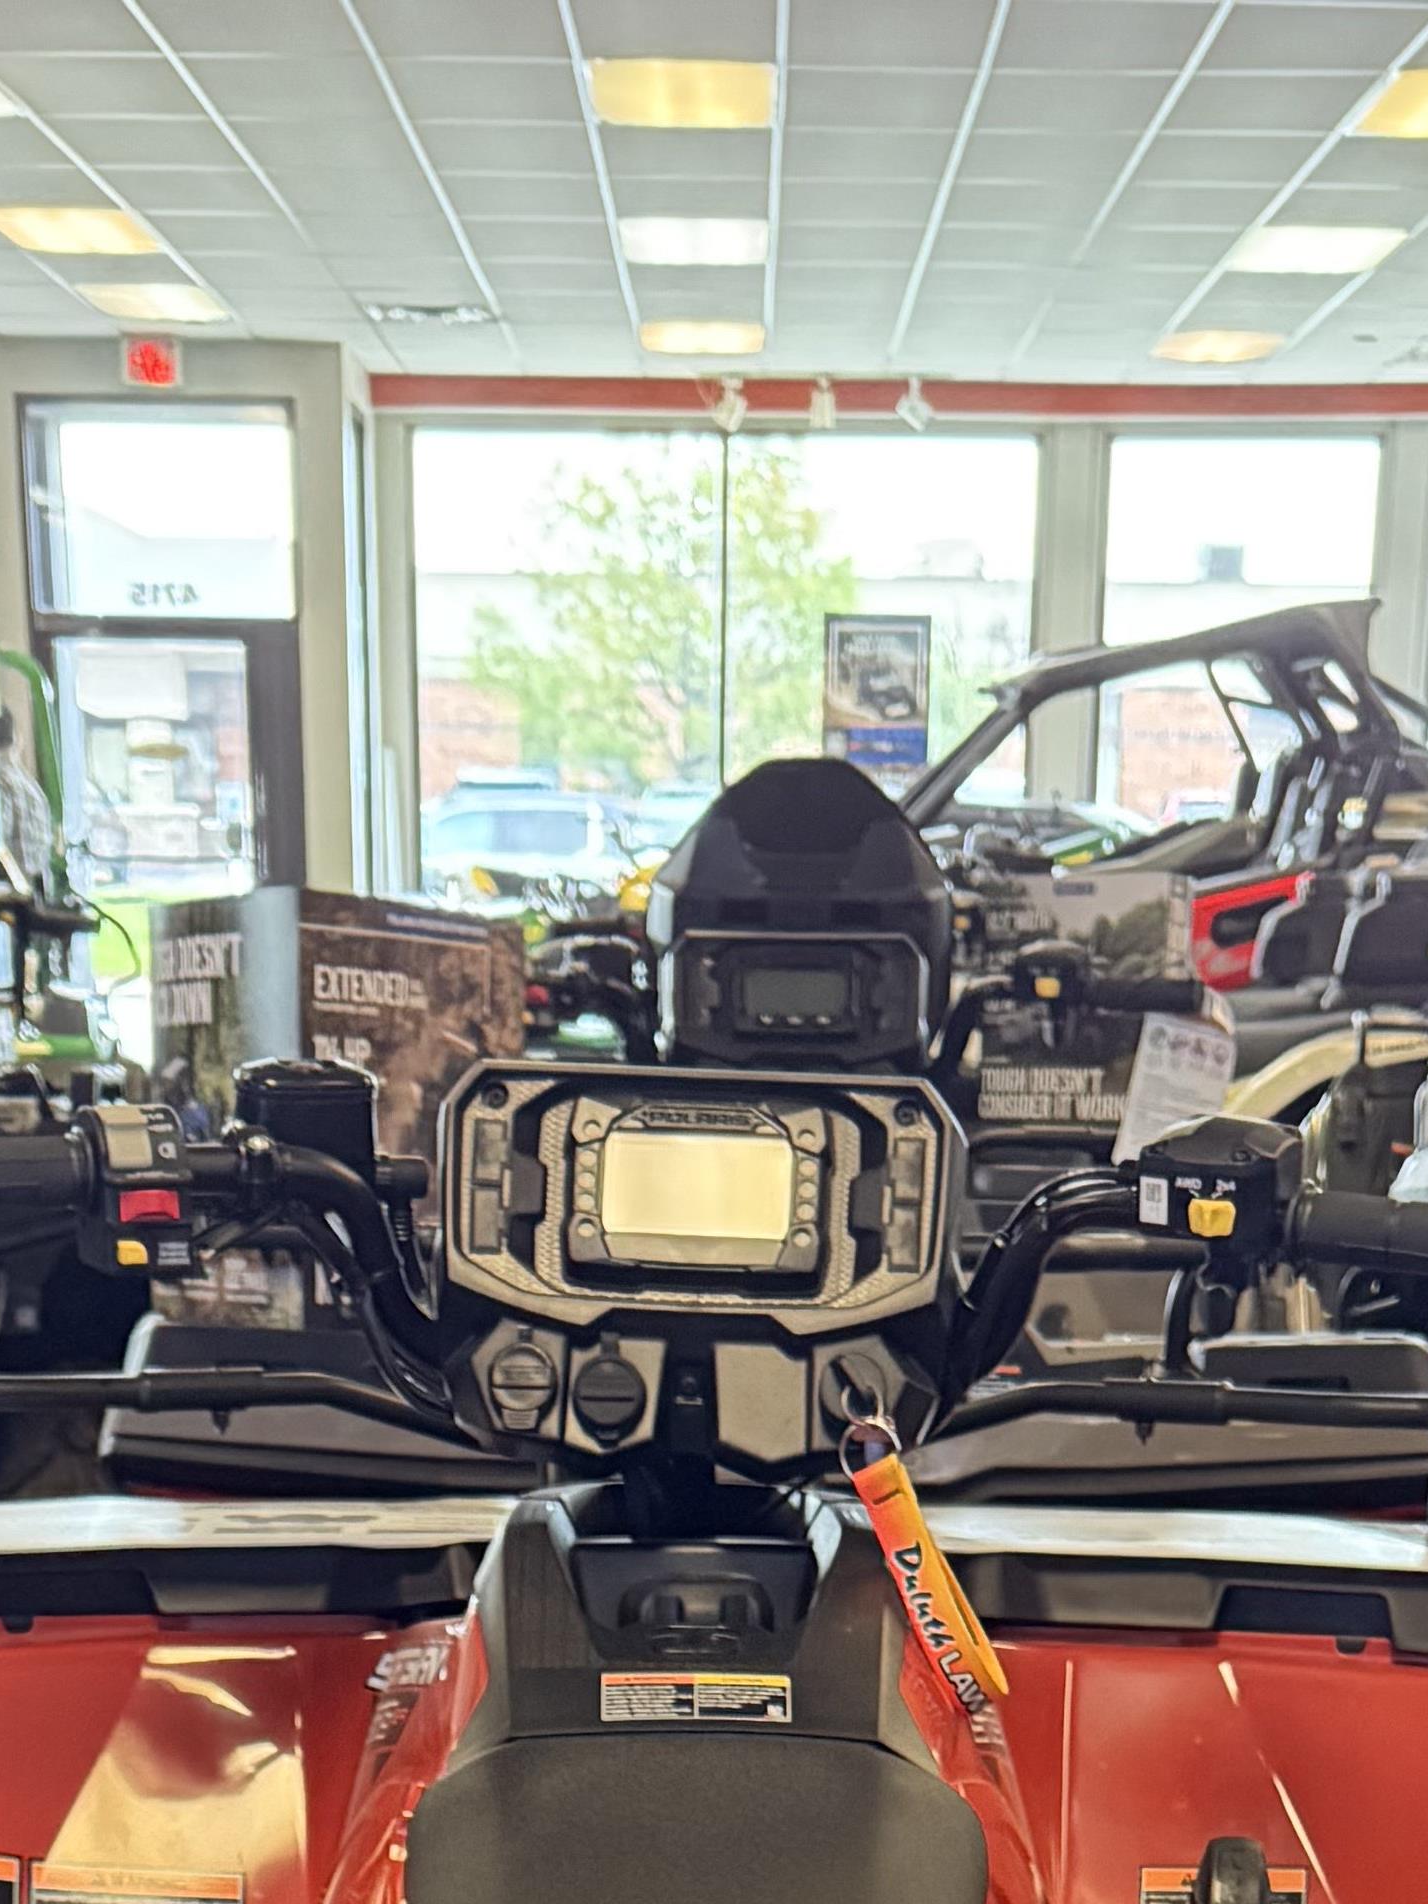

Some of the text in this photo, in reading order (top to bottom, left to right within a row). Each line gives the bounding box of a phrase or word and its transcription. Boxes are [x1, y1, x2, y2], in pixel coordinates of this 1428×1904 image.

[313, 963, 410, 1007] EXTENDED
[981, 1067, 1027, 1093] TOUGH
[892, 1541, 956, 1650] Duluth
